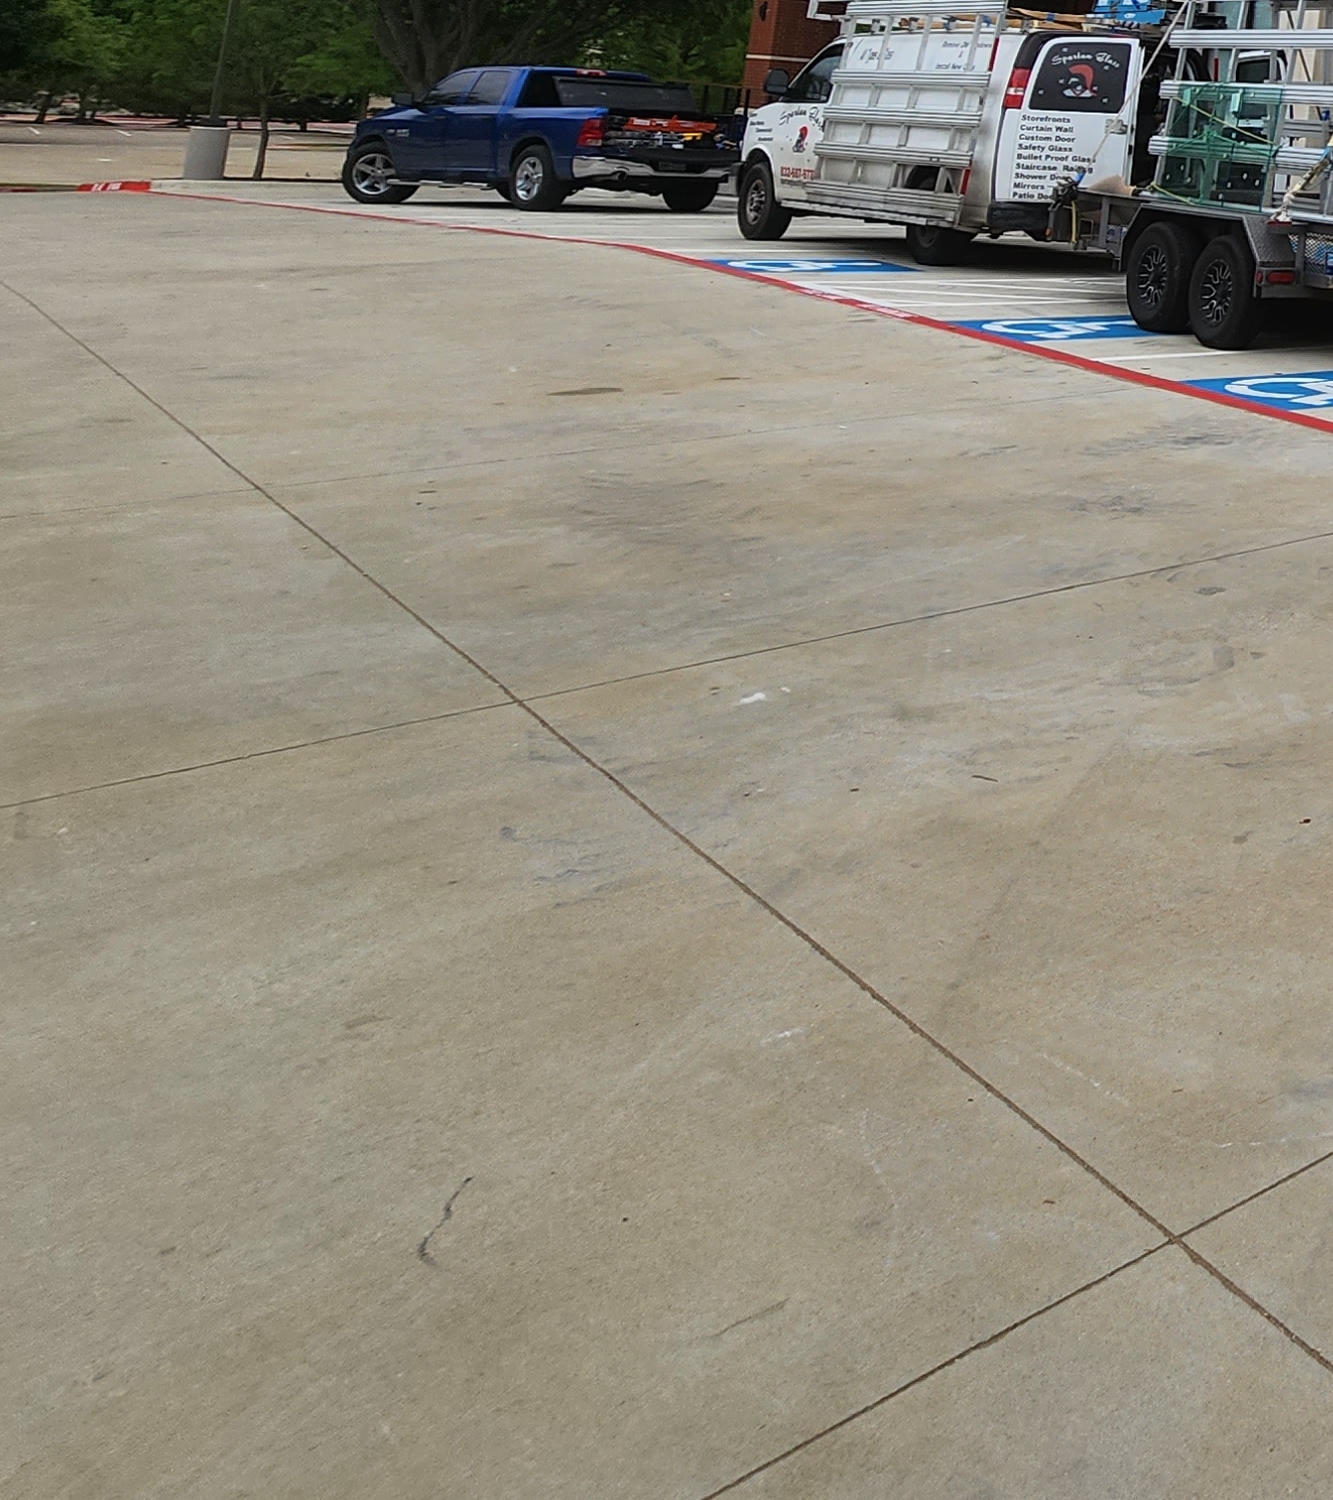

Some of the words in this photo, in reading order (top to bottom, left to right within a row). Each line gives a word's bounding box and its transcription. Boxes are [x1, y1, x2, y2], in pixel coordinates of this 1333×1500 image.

[1021, 114, 1071, 123] Storefronts
[1020, 124, 1052, 132] Curtain
[1019, 134, 1052, 142] Custom
[1055, 135, 1076, 143] Door
[1017, 143, 1046, 153] Safety
[1016, 153, 1042, 161] Bullet
[1045, 154, 1069, 162] Proof
[1015, 163, 1058, 171] Staircase
[1014, 172, 1047, 180] Shower
[1013, 182, 1045, 190] Mirrors
[1012, 191, 1035, 199] Patio
